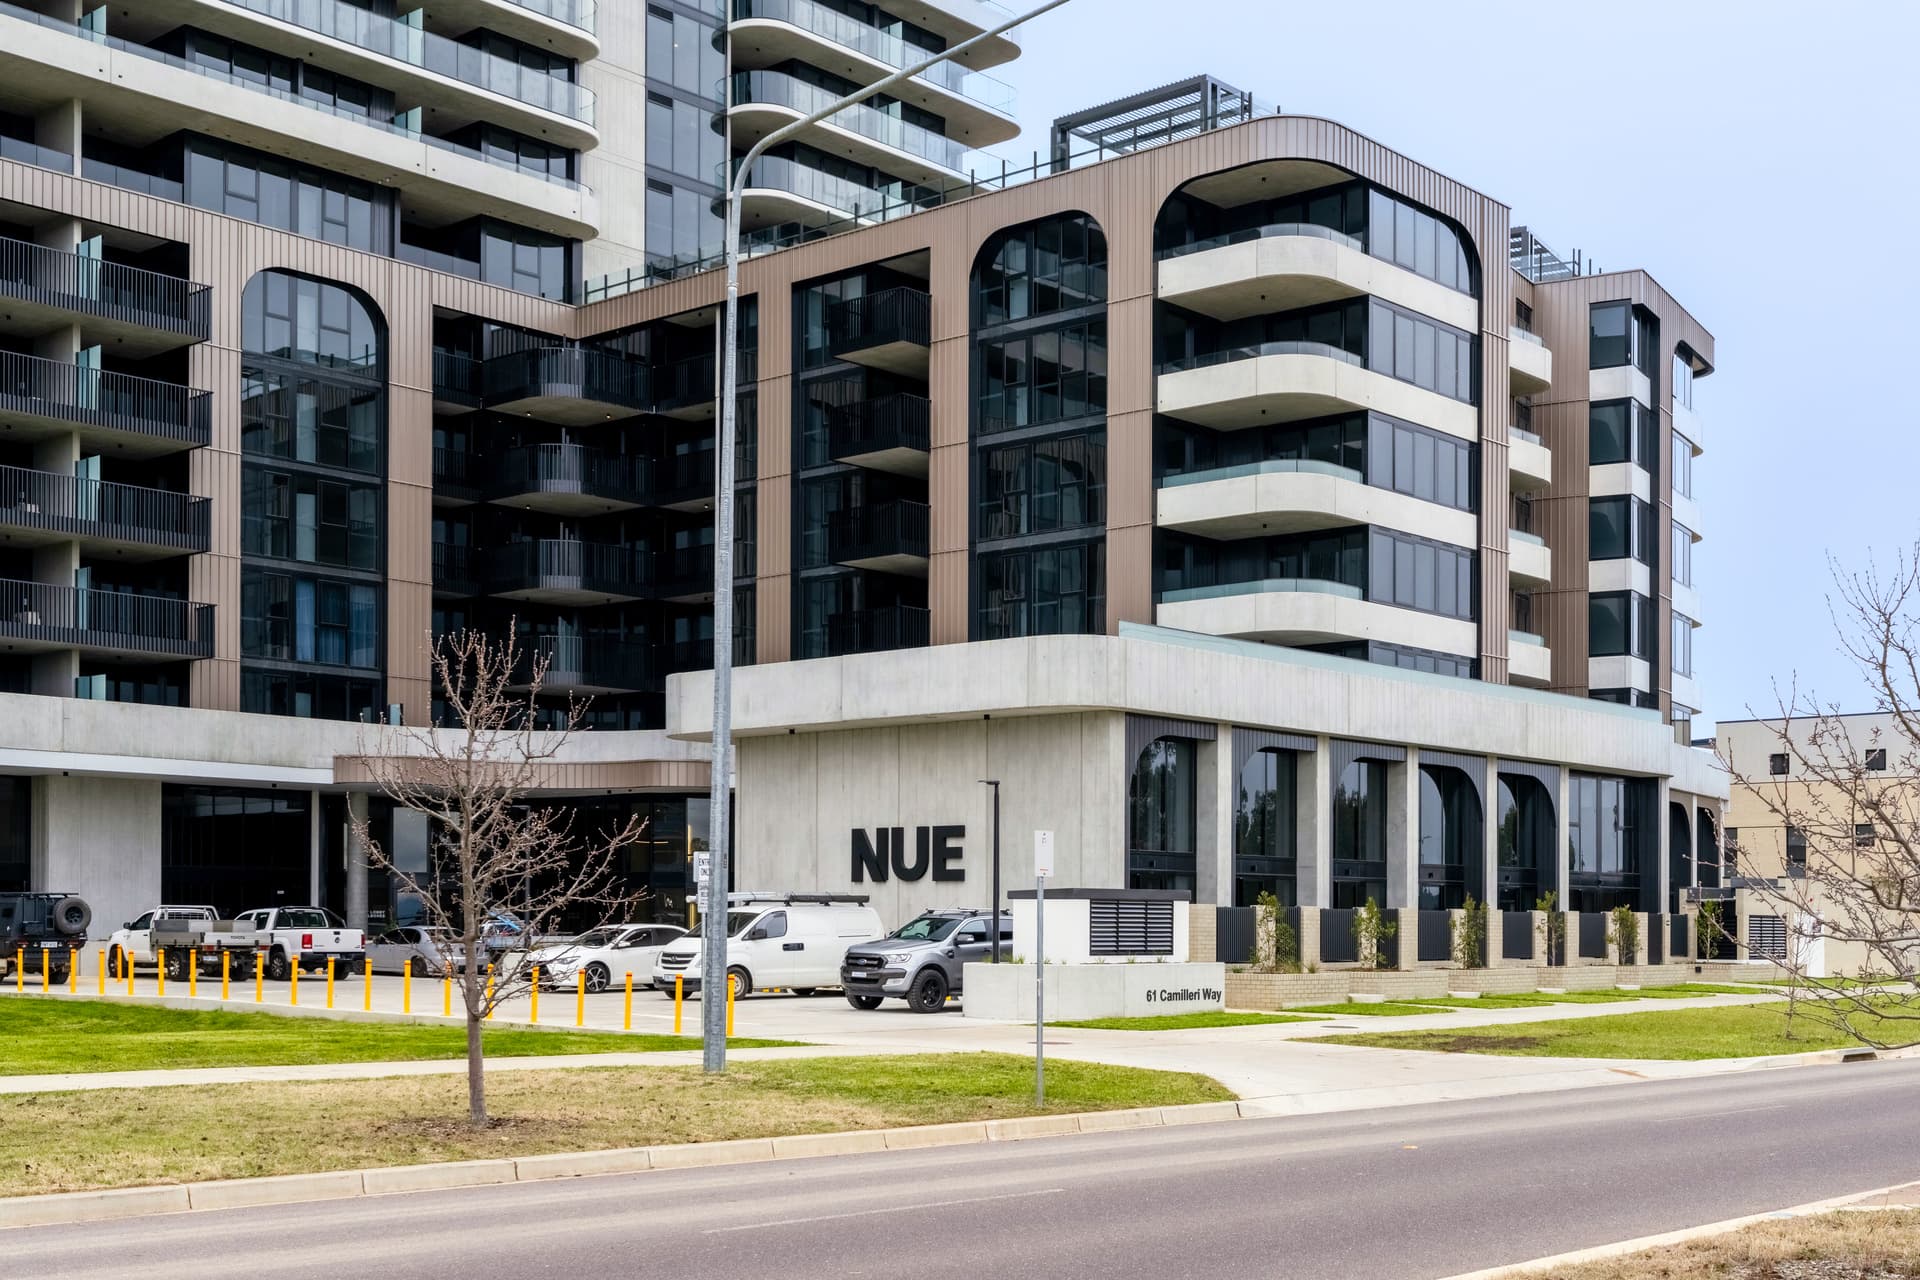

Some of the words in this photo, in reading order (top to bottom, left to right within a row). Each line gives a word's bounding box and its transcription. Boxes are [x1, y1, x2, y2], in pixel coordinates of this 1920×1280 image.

[851, 825, 965, 882] NUE
[1146, 989, 1157, 1002] 61
[1160, 988, 1200, 1002] Camilleri
[1202, 987, 1222, 1003] Way
